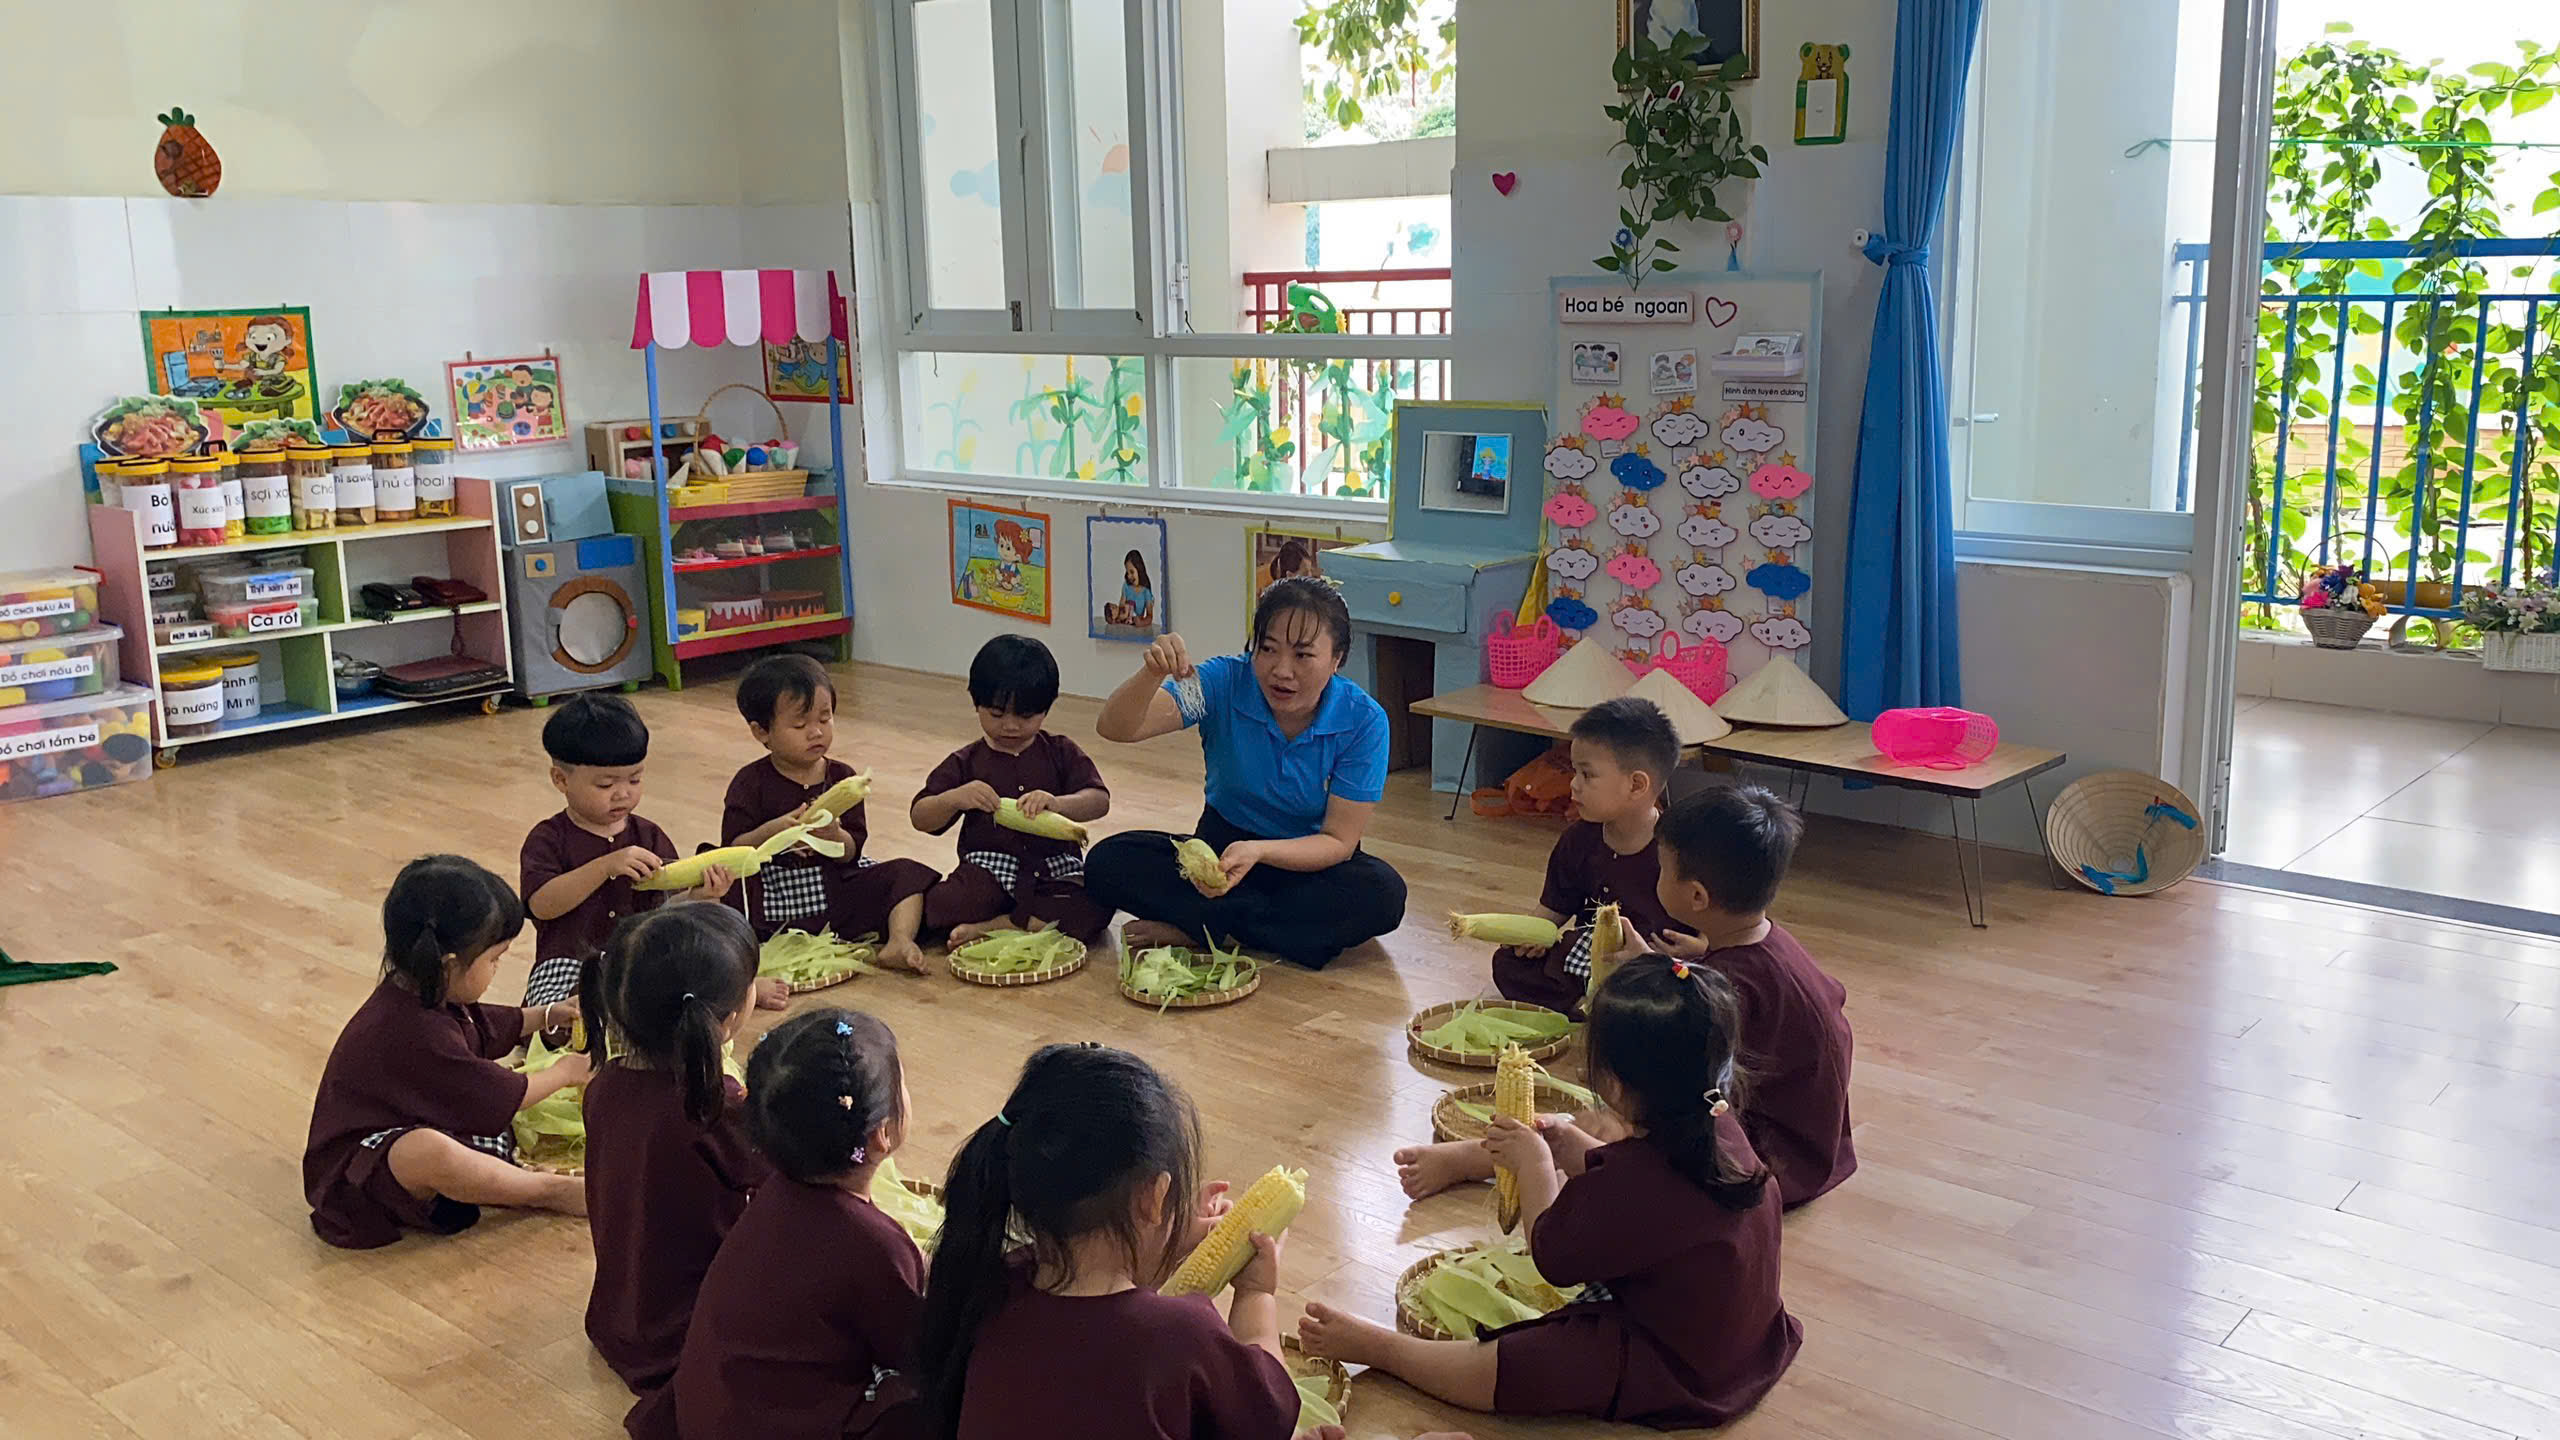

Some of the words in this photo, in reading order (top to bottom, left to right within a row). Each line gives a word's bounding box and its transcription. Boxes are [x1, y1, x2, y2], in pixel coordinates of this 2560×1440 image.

[1565, 297, 1598, 313] Hoa
[1603, 296, 1625, 313] bé
[1634, 300, 1688, 318] ngoan
[151, 493, 169, 508] Bò
[250, 614, 273, 628] Cà
[278, 609, 298, 625] rốt
[17, 741, 46, 753] chơi
